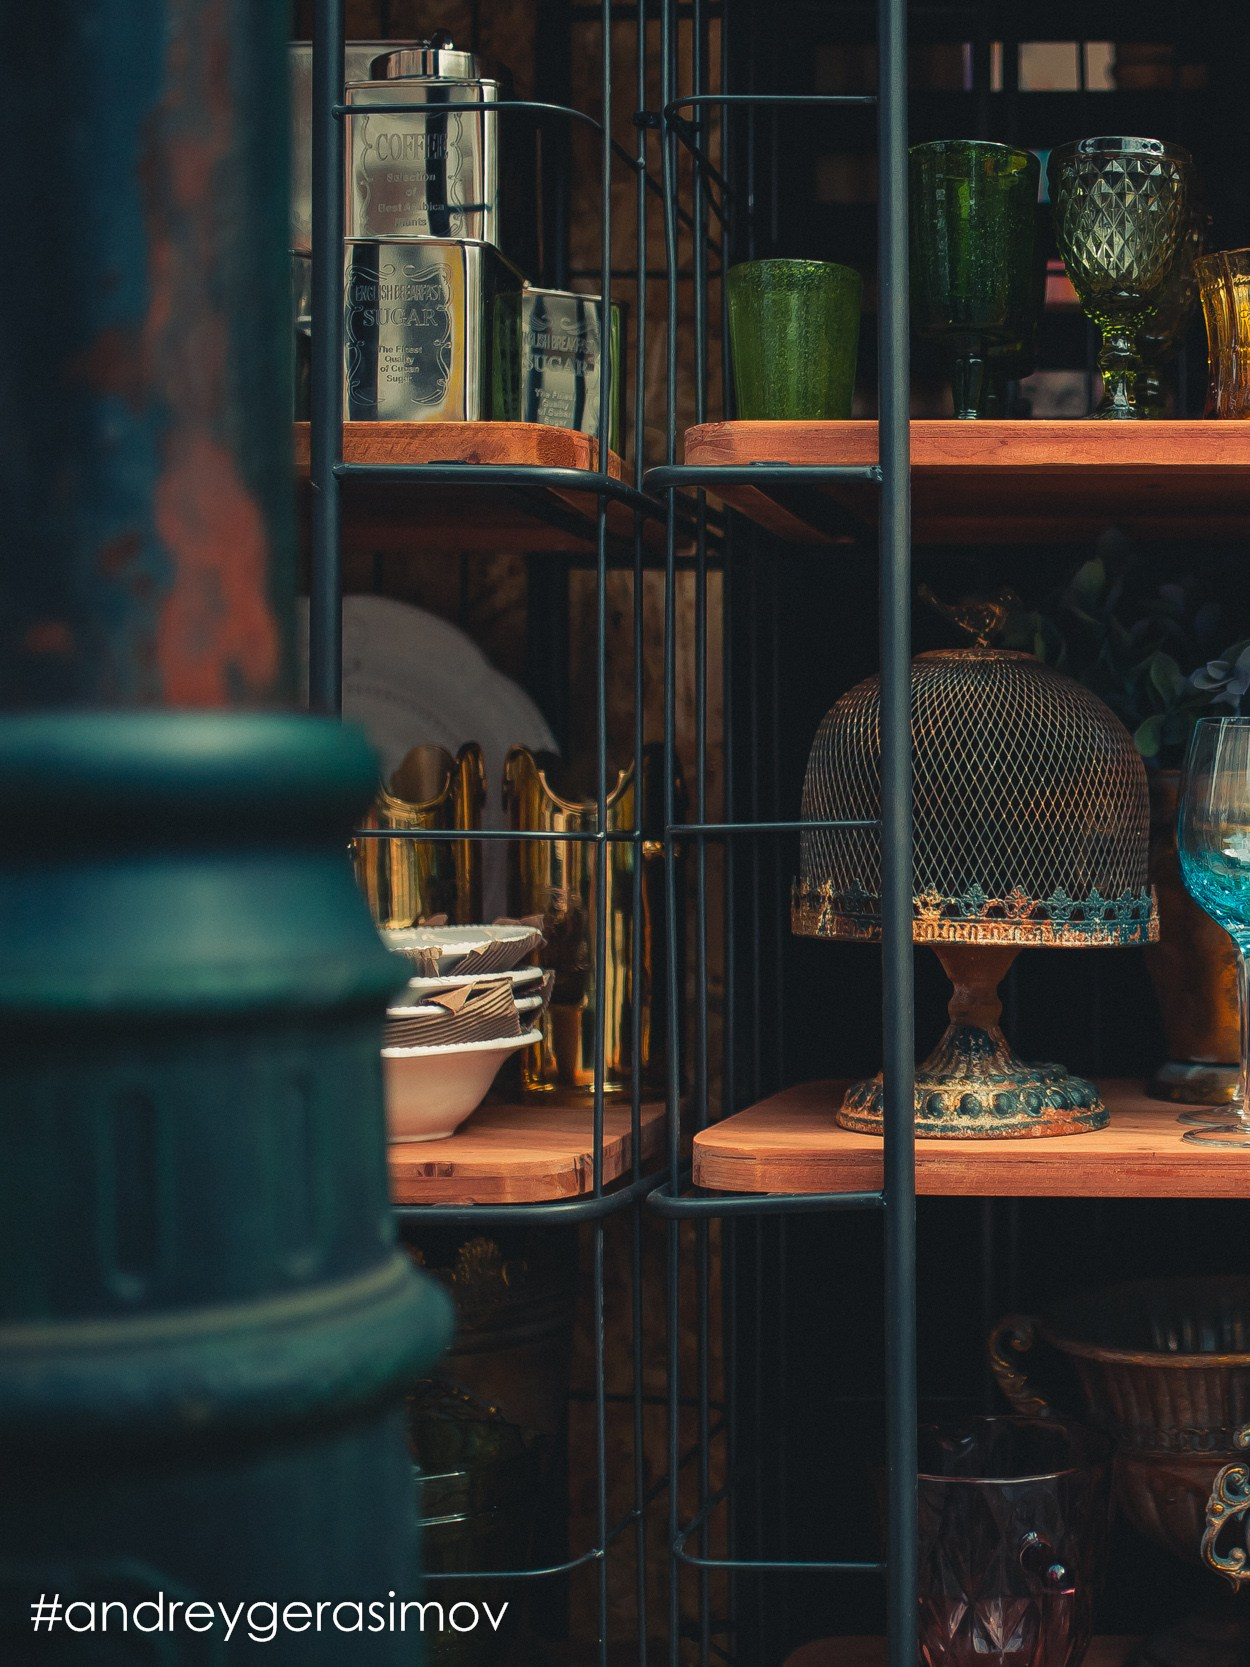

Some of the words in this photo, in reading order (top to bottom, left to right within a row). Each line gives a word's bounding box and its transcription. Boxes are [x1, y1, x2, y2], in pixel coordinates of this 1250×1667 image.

[376, 133, 449, 161] COFFEE
[386, 172, 436, 183] Selection
[355, 284, 393, 301] ENGLISH
[394, 284, 441, 301] BREAKFAST
[363, 308, 439, 327] SUGAR
[378, 345, 394, 354] The
[380, 365, 389, 373] of
[386, 375, 413, 384] Sugar
